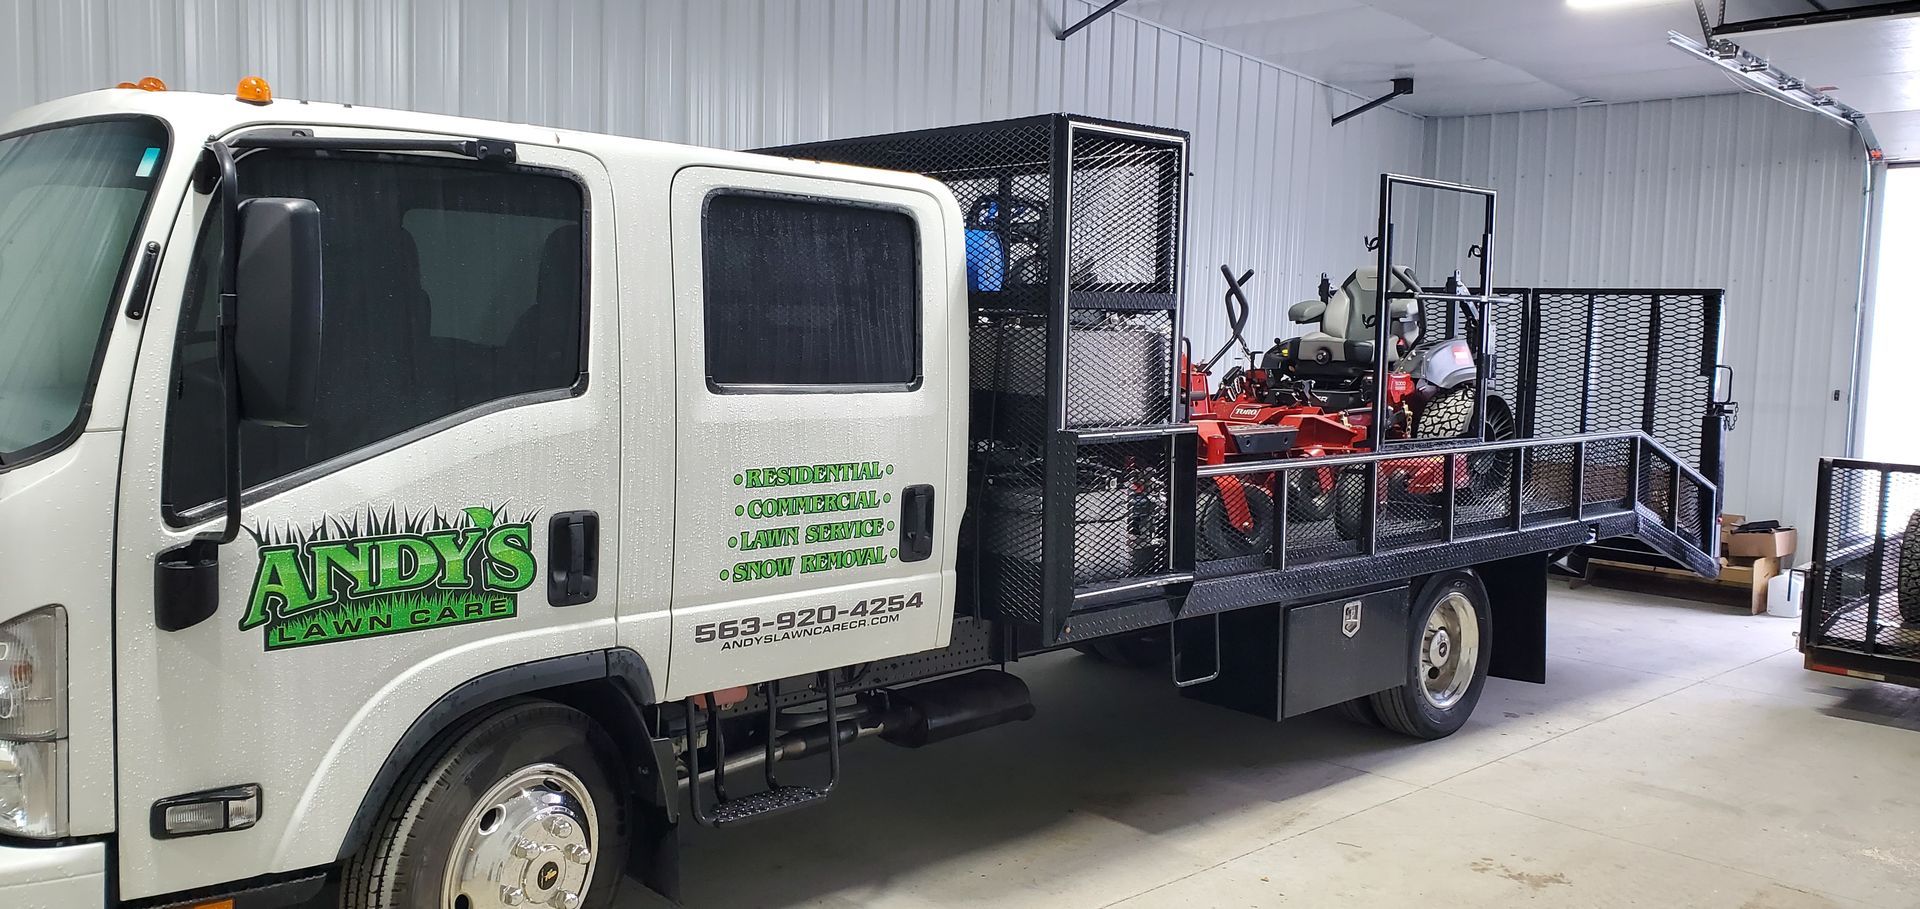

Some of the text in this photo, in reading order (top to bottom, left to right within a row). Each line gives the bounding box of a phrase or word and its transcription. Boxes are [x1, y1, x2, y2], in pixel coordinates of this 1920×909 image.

[1235, 408, 1258, 416] TORO
[745, 461, 884, 488] RESIDENTIAL
[747, 490, 881, 519] COMMERCIAL
[740, 518, 885, 551] LAWN SERVICE
[238, 506, 538, 632] ANDY'S
[732, 546, 887, 583] SNOW REMOVAL
[278, 598, 508, 644] LAWN CARE
[694, 592, 924, 644] 563-920-4254
[720, 613, 900, 651] ANDYSLAWNCARECR.COM
